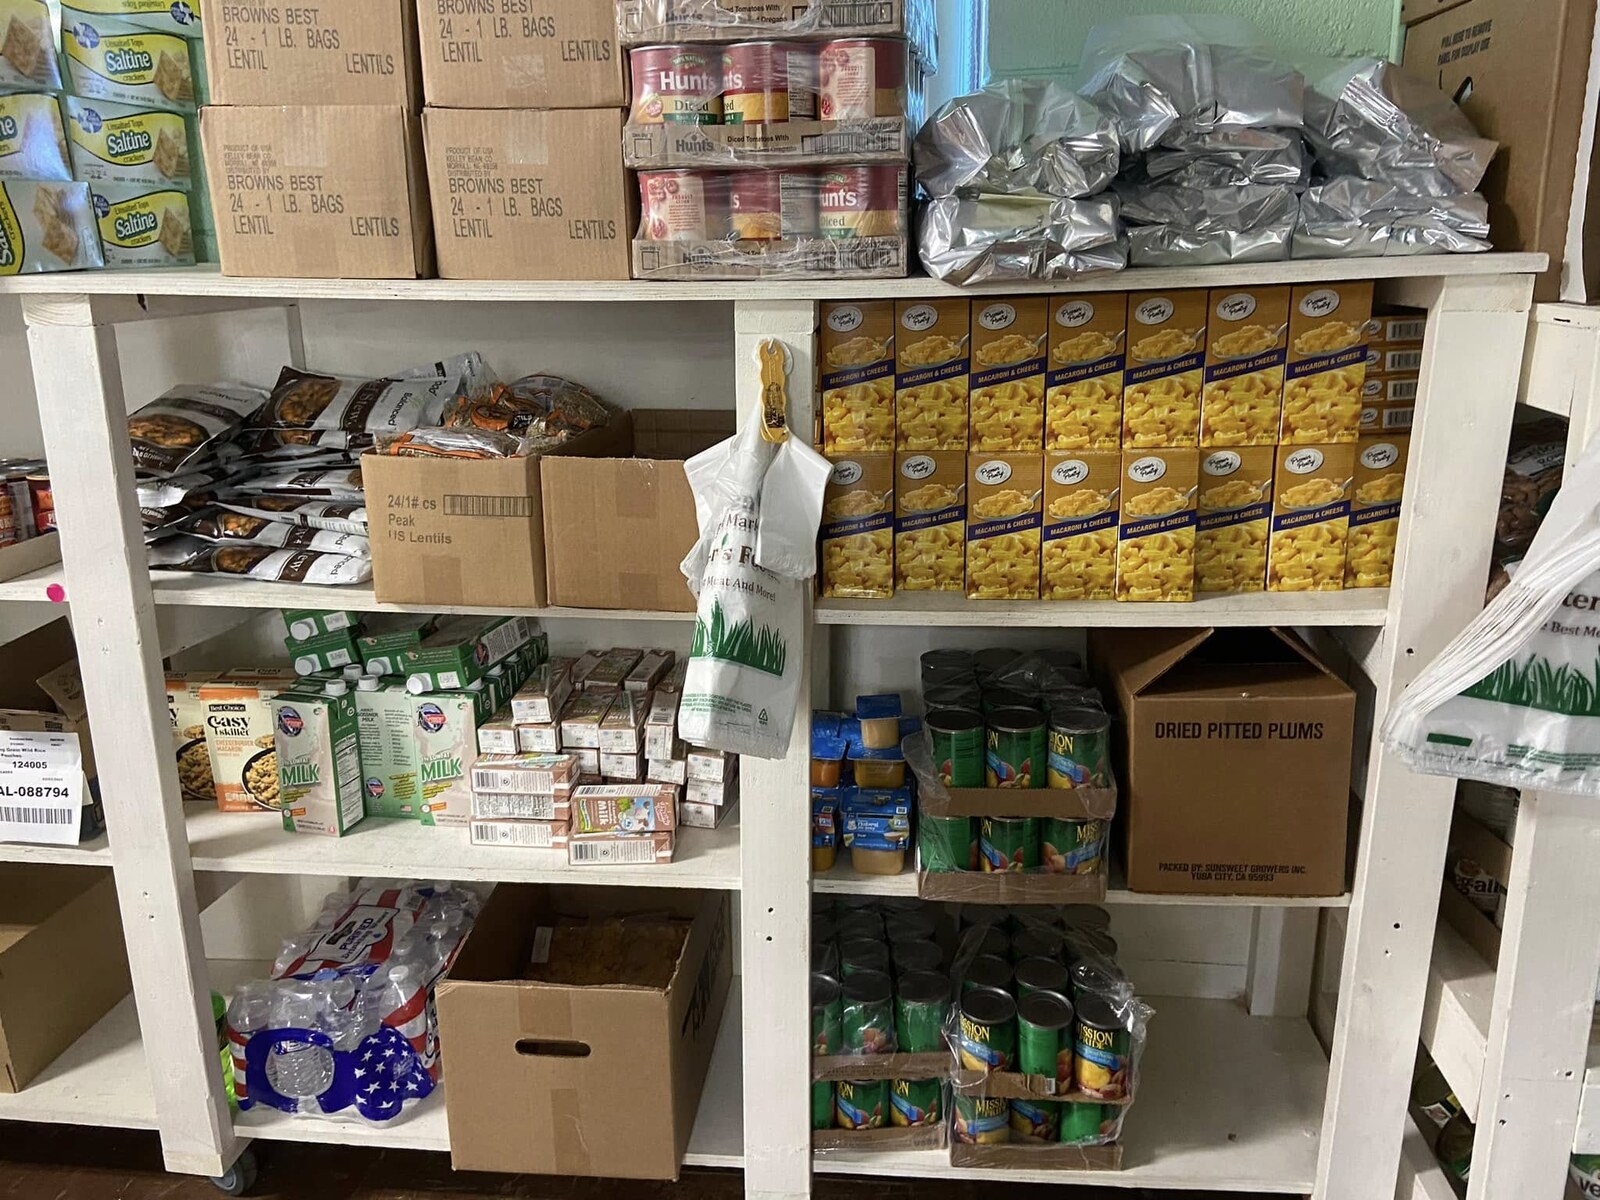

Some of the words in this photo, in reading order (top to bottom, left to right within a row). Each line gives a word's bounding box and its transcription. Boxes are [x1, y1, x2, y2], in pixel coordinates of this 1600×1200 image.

[223, 7, 279, 24] BROWNS
[286, 8, 319, 25] BEST
[438, 0, 494, 15] BROWNS
[502, 0, 533, 14] BEST
[225, 26, 237, 46] 24
[279, 28, 296, 48] LB.
[307, 29, 340, 49] BAGS
[439, 18, 452, 39] 24
[494, 18, 512, 38] LB.
[523, 17, 555, 38] BAGS
[106, 50, 151, 72] Saltine
[442, 42, 482, 63] LENTIL
[561, 40, 610, 62] LENTILS
[228, 49, 268, 70] LENTIL
[346, 53, 394, 75] LENTILS
[107, 131, 150, 154] Saltine
[775, 134, 789, 142] With
[228, 175, 284, 191] BROWNS
[290, 176, 323, 191] BEST
[450, 178, 504, 193] BROWNS
[511, 178, 543, 194] BEST
[230, 194, 243, 212] 24
[283, 195, 301, 213] LB.
[311, 194, 344, 213] BAGS
[451, 197, 464, 216] 24
[503, 198, 521, 217] LB.
[531, 197, 563, 217] BAGS
[115, 212, 156, 238] Saltine
[233, 215, 274, 235] LENTIL
[350, 216, 399, 237] LENTILS
[453, 218, 492, 238] LENTIL
[568, 220, 616, 239] LENTILS
[1055, 369, 1087, 382] MACARONI
[1088, 366, 1093, 374] &
[1094, 360, 1117, 372] CHEESE
[1133, 366, 1166, 380] MACARONI
[1173, 358, 1197, 370] CHEESE
[1213, 363, 1247, 376] MACARONI
[1248, 361, 1253, 369] &
[1254, 354, 1278, 366] CHEESE
[1294, 359, 1329, 373] MACARONI
[1330, 357, 1335, 365] &
[1336, 351, 1360, 363] CHEESE
[829, 371, 860, 384] MACARONI
[866, 365, 888, 376] CHEESE
[902, 371, 933, 384] MACARONI
[940, 364, 962, 375] CHEESE
[978, 371, 1010, 384] MACARONI
[1016, 363, 1040, 374] CHEESE
[387, 494, 419, 510] 24/1#
[423, 498, 437, 511] cs
[388, 513, 416, 527] Peak
[865, 517, 886, 527] CHEESE
[902, 516, 931, 528] MACARONI
[938, 510, 959, 520] CHEESE
[1201, 514, 1233, 526] MACARONI
[1240, 507, 1263, 518] CHEESE
[1281, 514, 1314, 526] MACARONI
[1315, 511, 1320, 519] &
[1321, 505, 1344, 517] CHEESE
[1356, 509, 1389, 521] MACARONI
[975, 524, 1006, 535] MACARONI
[1013, 517, 1035, 527] CHEESE
[1050, 523, 1082, 535] MACARONI
[1089, 516, 1111, 527] CHEESE
[1127, 522, 1159, 535] MACARONI
[1166, 515, 1189, 526] CHEESE
[409, 531, 452, 545] Lentils
[733, 578, 754, 592] And
[756, 585, 776, 601] More!
[1551, 624, 1580, 636] Best
[207, 716, 250, 730] easy
[219, 728, 249, 736] skillet
[1155, 722, 1202, 739] DRIED
[1207, 722, 1262, 739] PITTED
[1267, 722, 1324, 740] PLUMS
[12, 761, 47, 769] 124005
[421, 757, 463, 782] MILK
[281, 764, 320, 786] MILK
[0, 786, 69, 798] AL-088794
[1159, 863, 1188, 871] PACKED
[1205, 864, 1248, 873] SUNSWEET
[1250, 865, 1289, 873] GROWERS
[1191, 873, 1212, 881] YUBA
[1236, 873, 1246, 881] CA
[1248, 873, 1274, 881] 95993
[339, 917, 374, 950] PURIFIED
